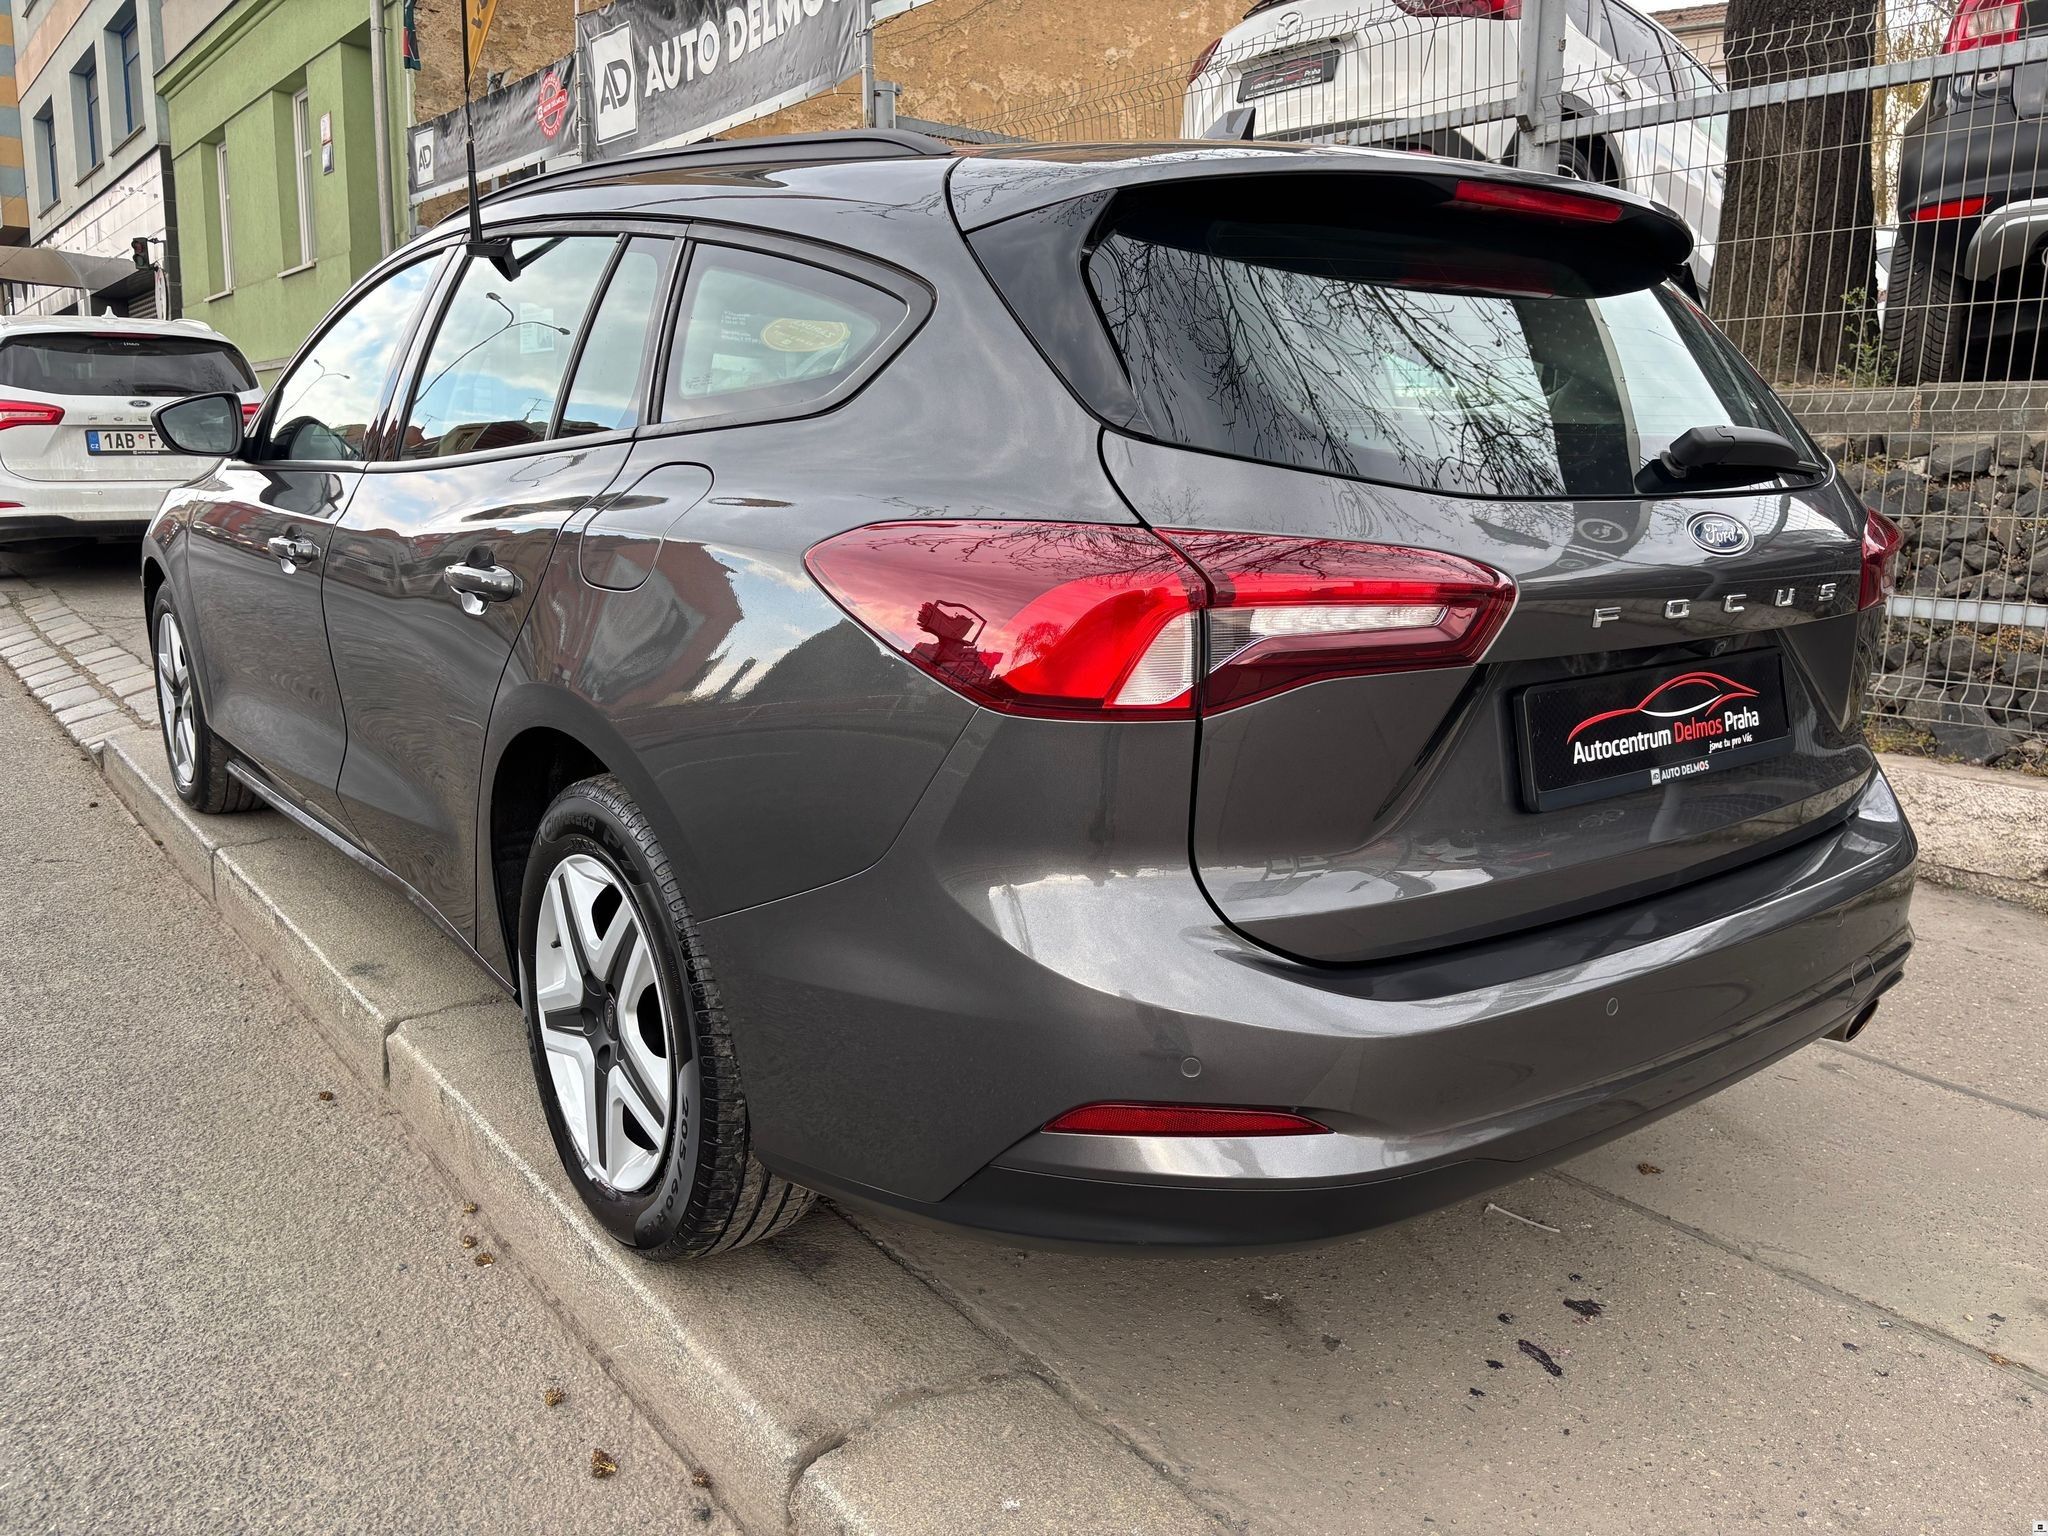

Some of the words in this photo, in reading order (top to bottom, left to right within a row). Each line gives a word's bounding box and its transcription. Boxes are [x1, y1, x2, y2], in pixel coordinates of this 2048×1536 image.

[645, 20, 720, 97] AUTO
[726, 0, 841, 63] DELM
[104, 433, 136, 449] 1AB
[1591, 582, 1838, 629] FOCUS
[1573, 728, 1672, 765] Autocentrum
[1674, 716, 1723, 744] Delmos
[1724, 706, 1760, 732] Praha
[1708, 740, 1723, 754] jsme
[1724, 737, 1731, 748] tu
[1732, 737, 1742, 750] pro
[1661, 766, 1680, 780] AUTO
[1681, 760, 1710, 775] DELMOS
[666, 1094, 690, 1212] 205/60
